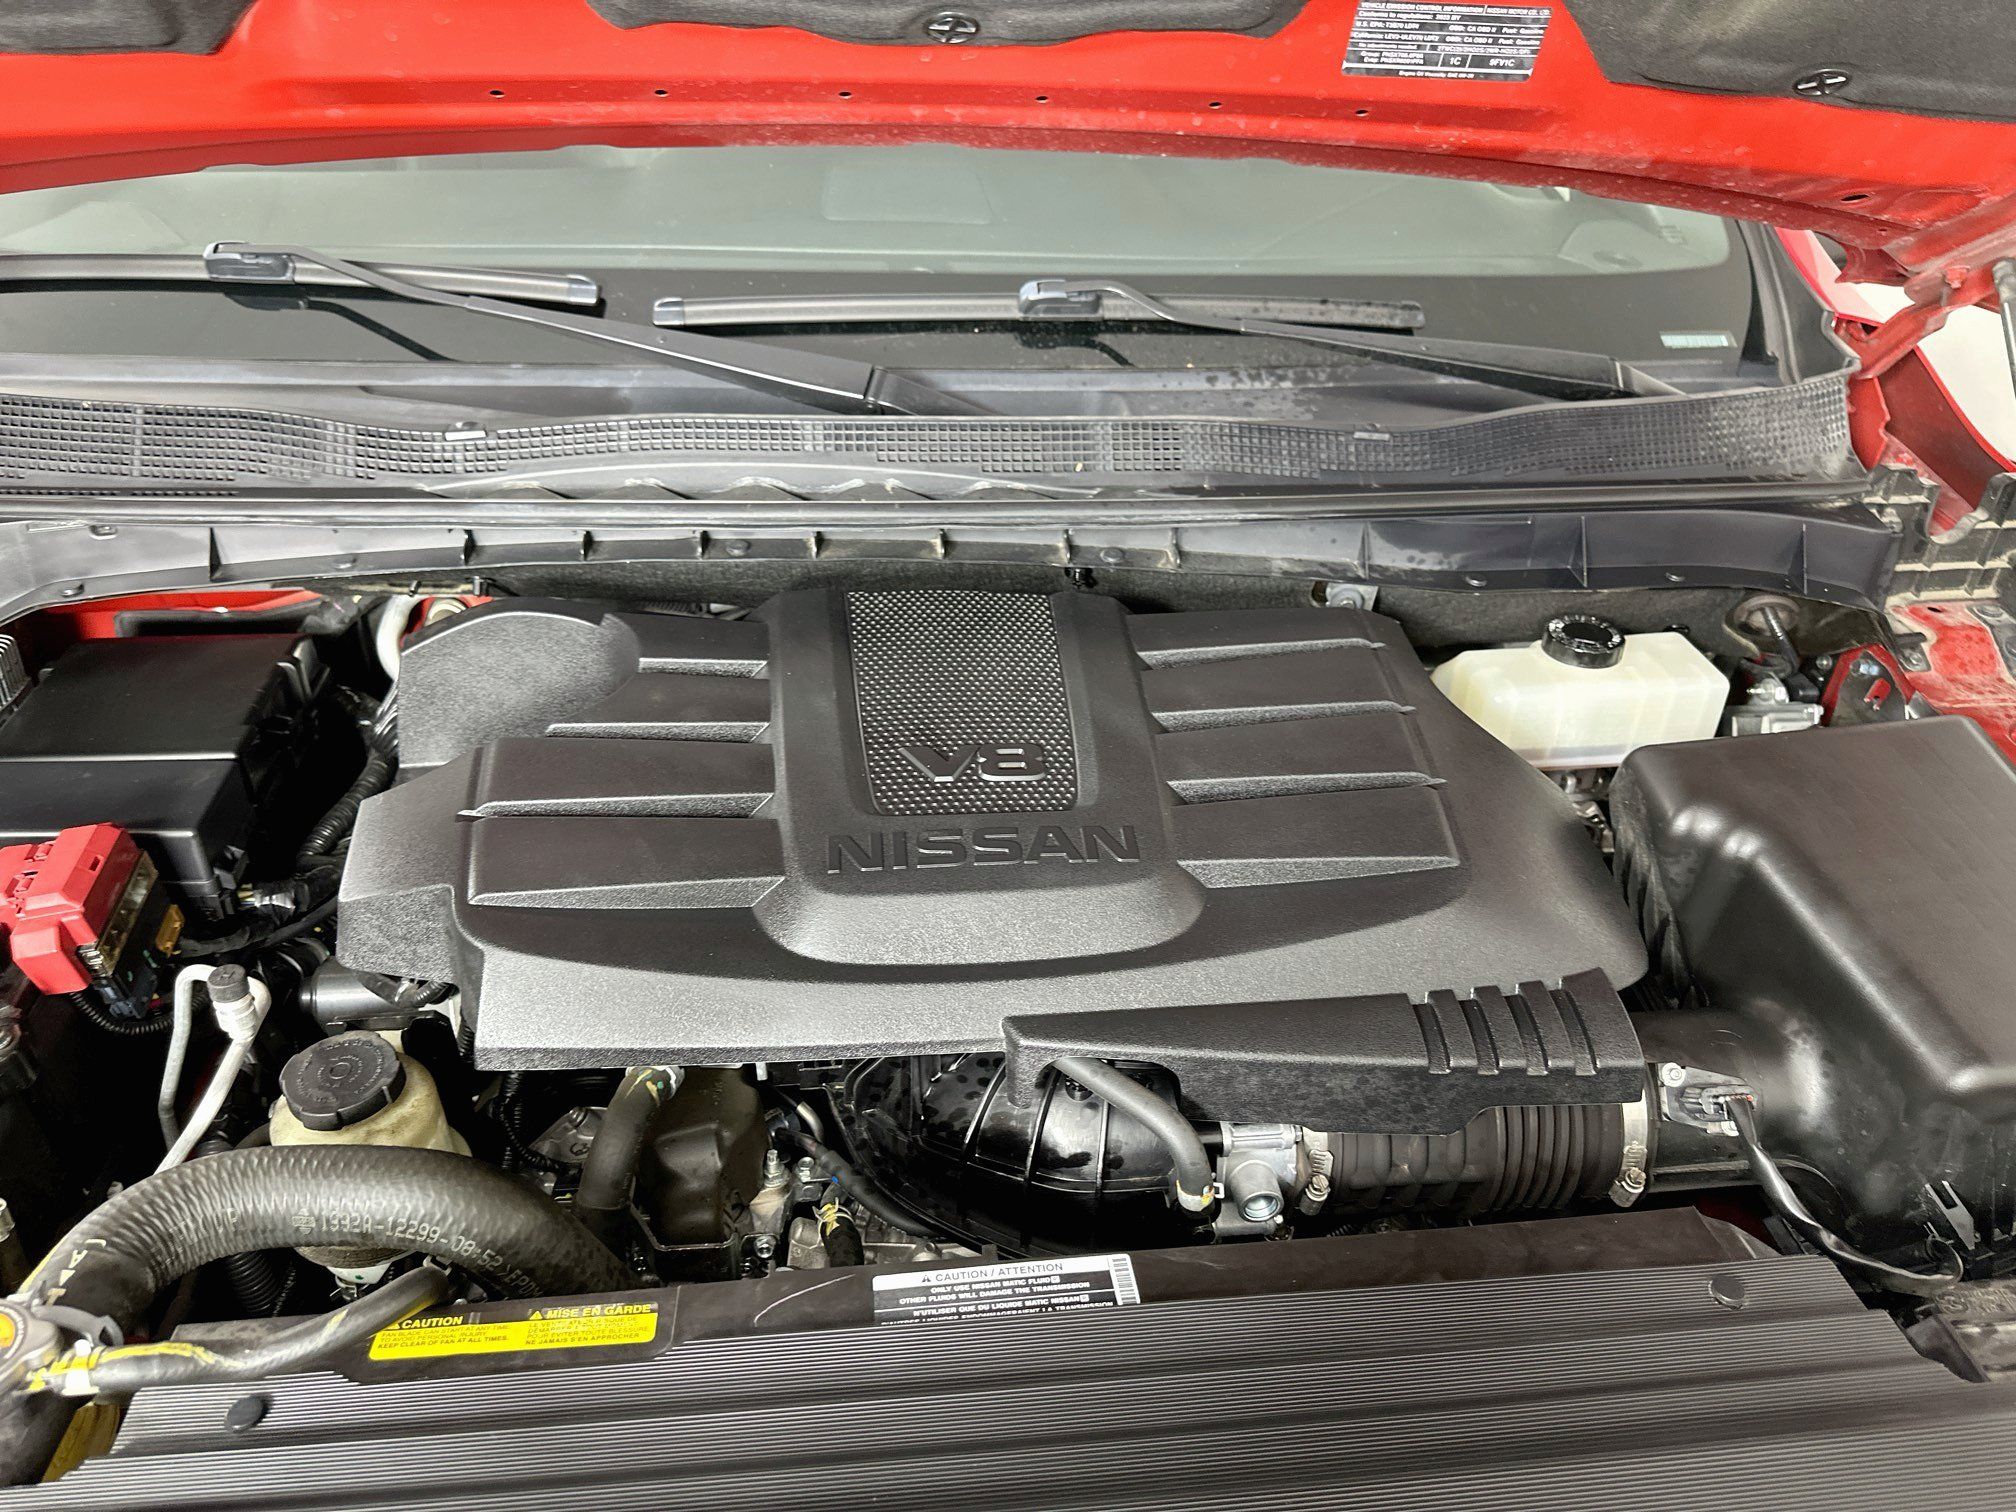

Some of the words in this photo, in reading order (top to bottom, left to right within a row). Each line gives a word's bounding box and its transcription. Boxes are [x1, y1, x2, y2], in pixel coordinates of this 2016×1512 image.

[1450, 57, 1461, 65] 1C
[899, 744, 1049, 782] V8
[827, 825, 1141, 874] NISSAN
[936, 1270, 987, 1281] CAUTION
[998, 1263, 1063, 1276] ATTENTION
[979, 1289, 1013, 1297] DAMAGE
[1032, 1282, 1090, 1292] TRANSMISSION
[1002, 1279, 1027, 1287] MATIC
[991, 1300, 1023, 1310] LIQUIDE
[1025, 1298, 1049, 1307] MATIC
[1051, 1296, 1080, 1304] NISSAN
[546, 1308, 580, 1319] MISE
[583, 1306, 601, 1317] EN
[604, 1304, 651, 1315] GARDE
[402, 1315, 463, 1329] CAUTION
